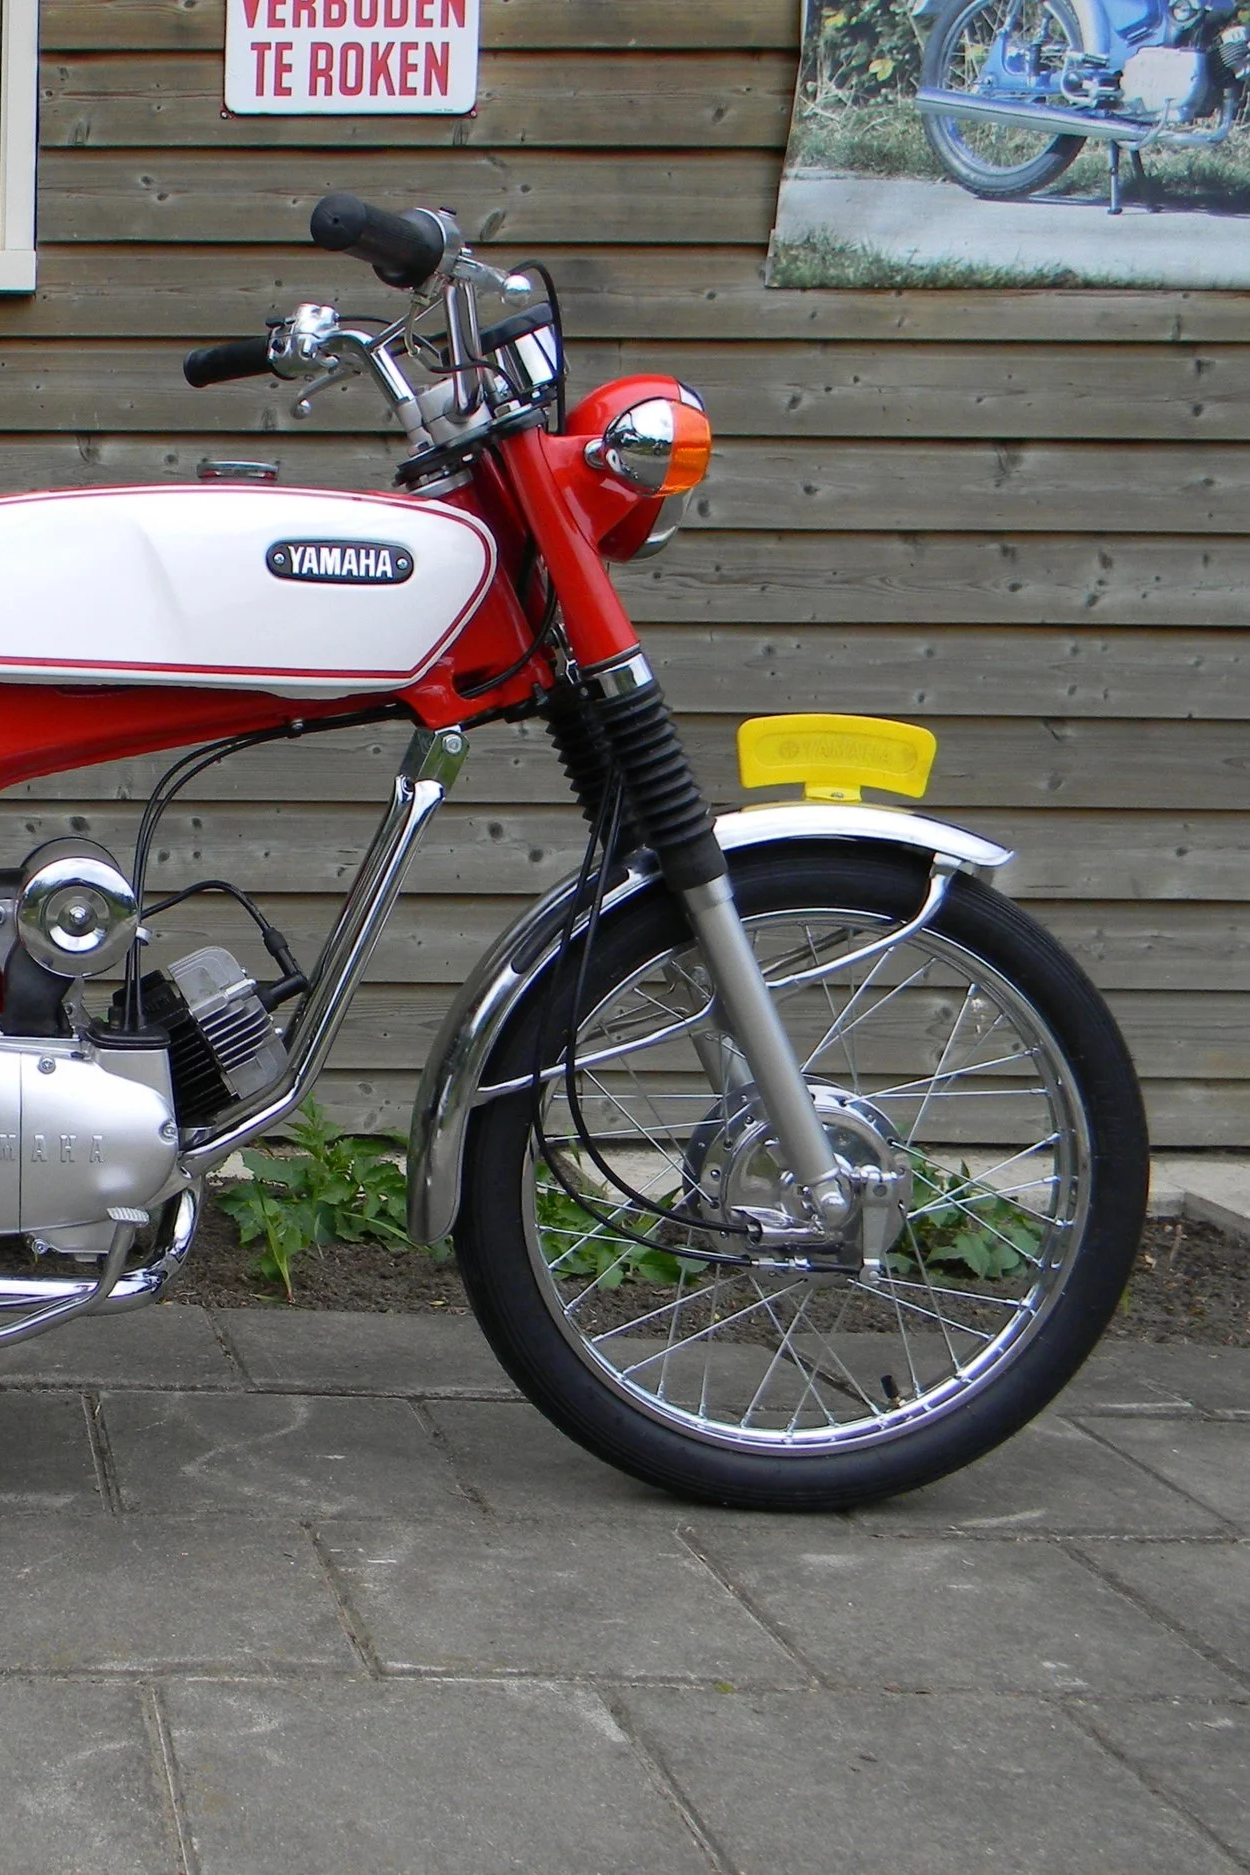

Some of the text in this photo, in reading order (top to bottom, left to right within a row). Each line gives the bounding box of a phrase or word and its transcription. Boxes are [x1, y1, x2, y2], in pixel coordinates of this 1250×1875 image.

[250, 41, 450, 97] TE ROKEN
[287, 545, 393, 578] YAMAHA
